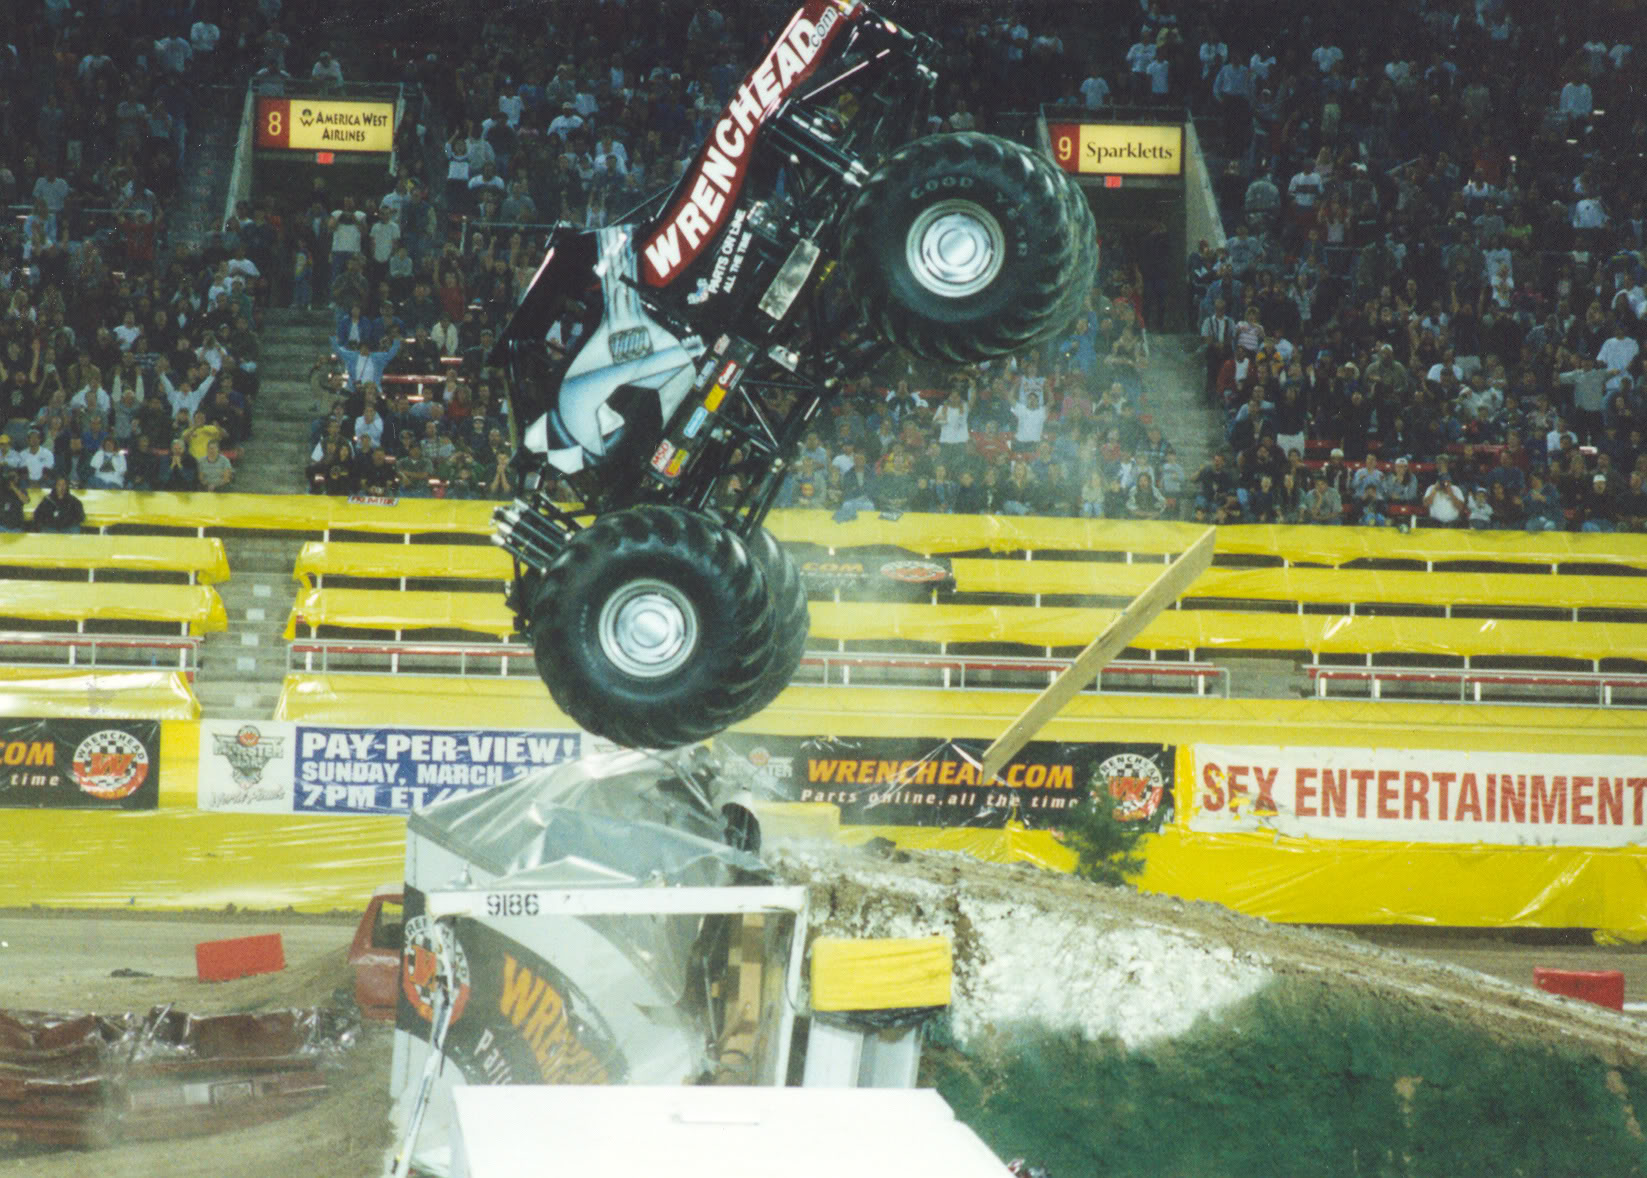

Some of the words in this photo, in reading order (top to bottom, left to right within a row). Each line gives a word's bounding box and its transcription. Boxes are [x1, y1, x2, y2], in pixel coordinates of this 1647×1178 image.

[267, 111, 281, 136] 8
[316, 112, 360, 126] AMERICA
[362, 113, 388, 127] WEST
[322, 128, 365, 142] AIRLINES
[1058, 136, 1072, 160] 9
[1086, 142, 1173, 163] Sparkletts
[0, 741, 55, 767] OM
[77, 732, 145, 760] WRENCHEAD
[302, 732, 575, 763] PAY-PER-VIEW!
[10, 773, 60, 786] time
[302, 761, 406, 784] SUNDAY,
[417, 763, 503, 785] MARCH
[302, 784, 375, 808] 7PM
[391, 786, 428, 812] ET
[801, 789, 857, 804] Parts
[986, 794, 1020, 808] the
[1203, 763, 1279, 817] SFX
[1295, 768, 1647, 826] ENTERTAINMENT
[486, 894, 539, 916] 9186
